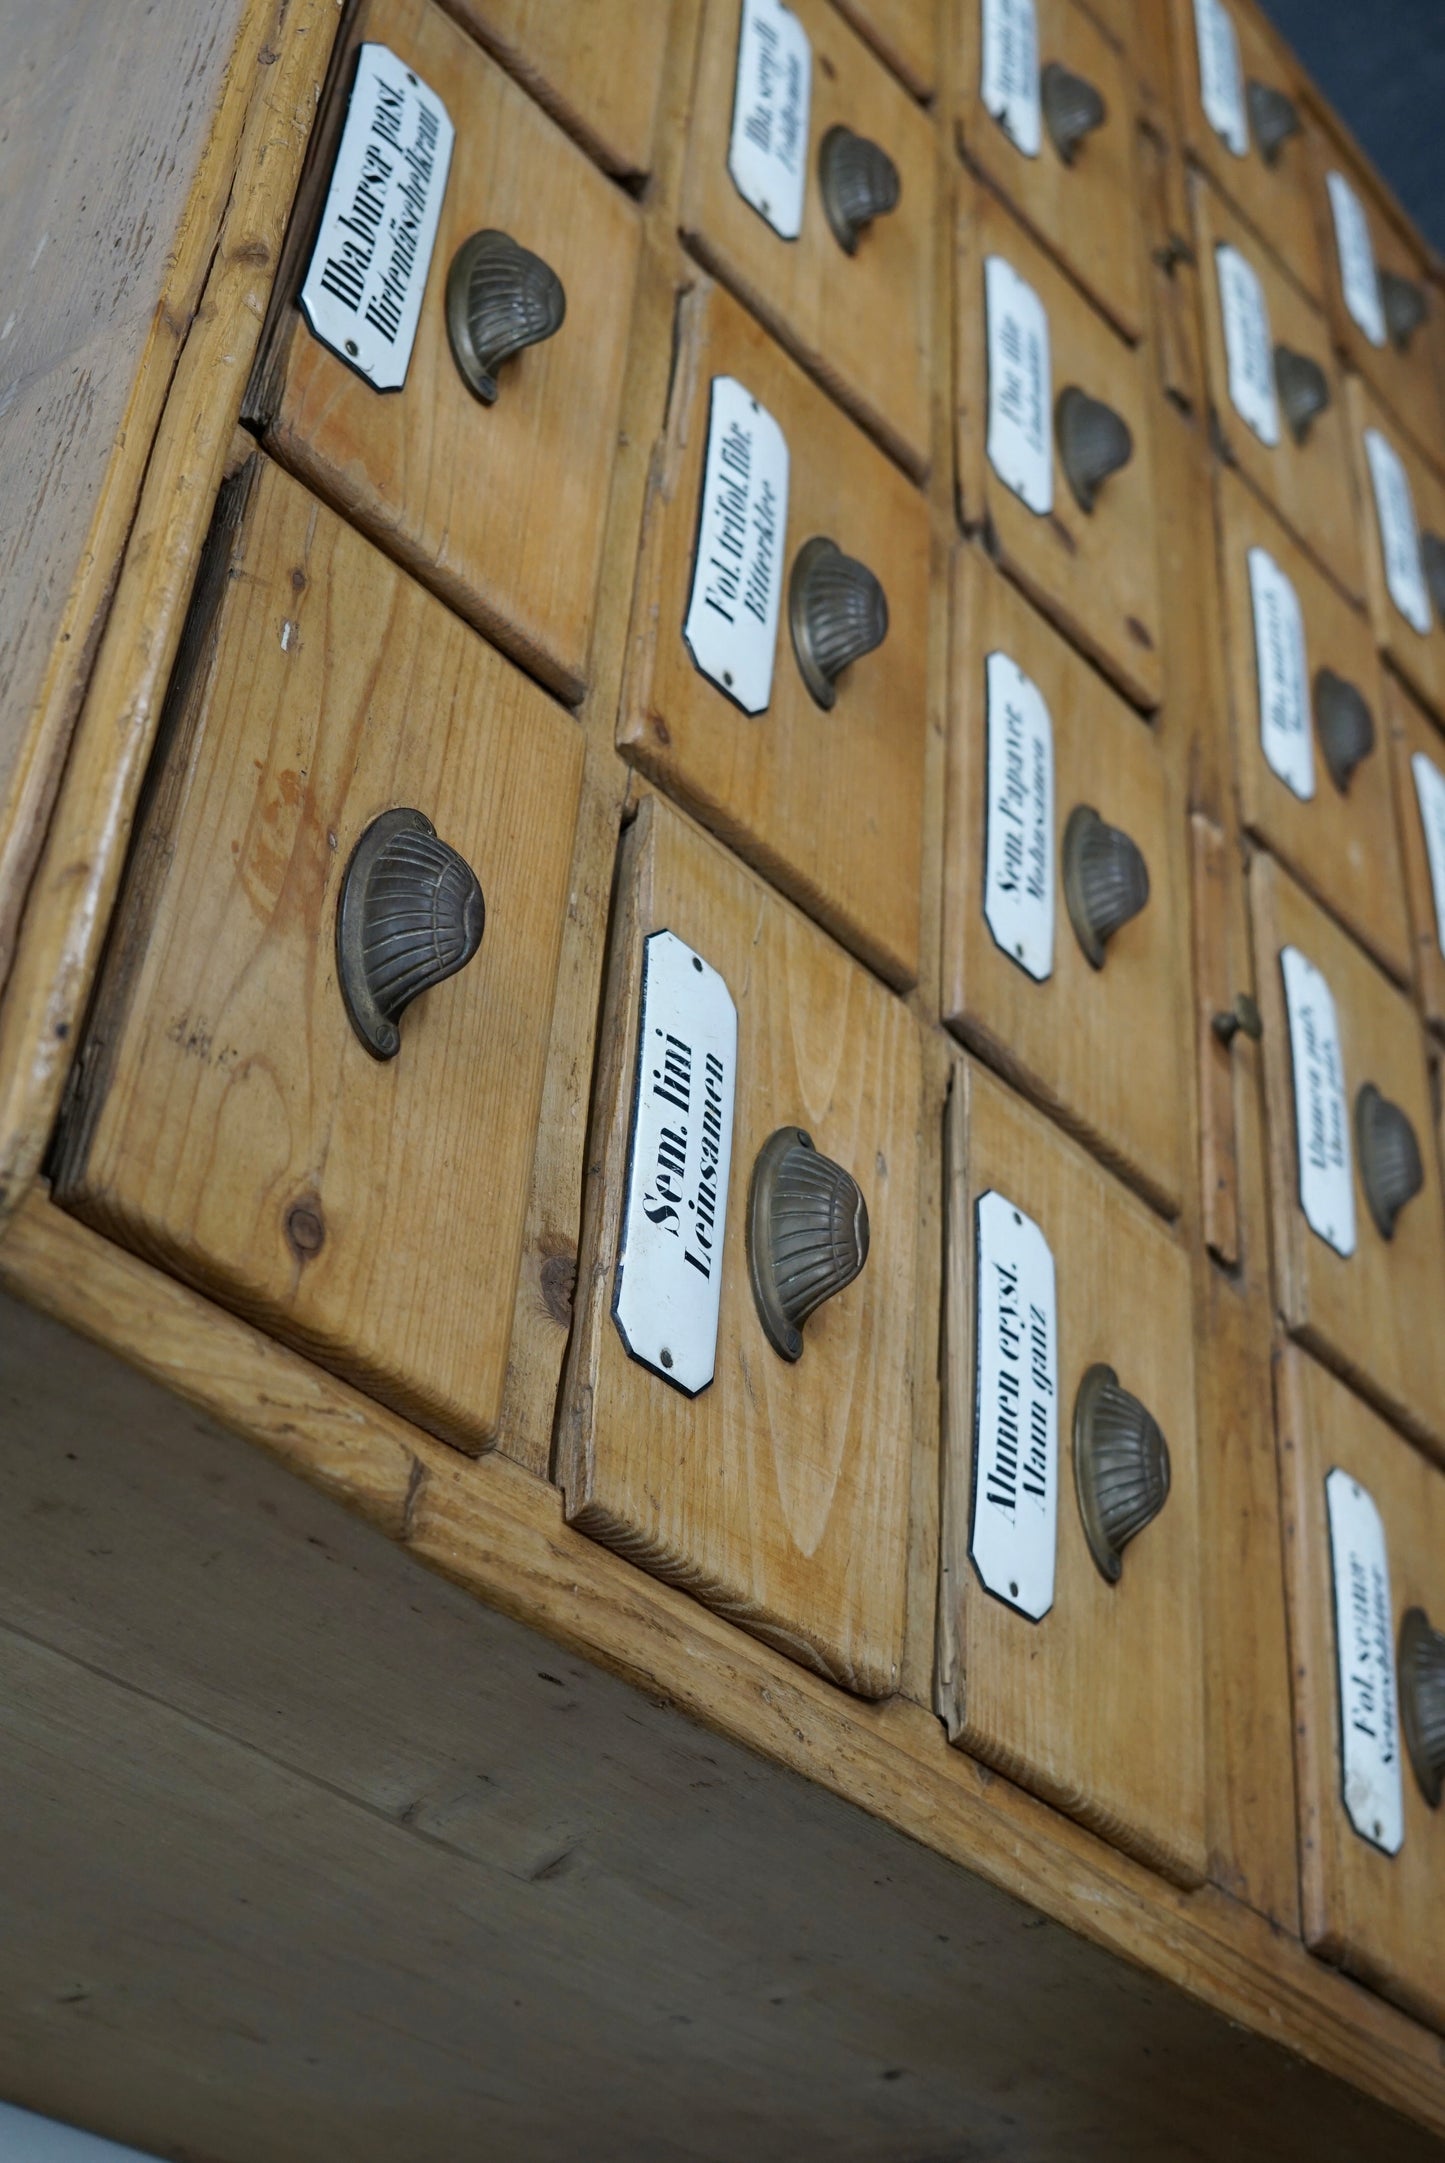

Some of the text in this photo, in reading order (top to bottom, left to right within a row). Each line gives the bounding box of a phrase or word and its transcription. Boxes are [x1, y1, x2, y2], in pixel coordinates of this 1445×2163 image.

[371, 76, 406, 156] past.
[365, 98, 440, 346] Hirtentäschelkraut
[705, 558, 741, 625] Fol.
[744, 481, 776, 626] Bitterklee
[643, 1028, 692, 1238] Sem. lini
[684, 1053, 724, 1281] Leinsamen
[986, 1262, 1026, 1525] Alumen cryst.
[1022, 1304, 1054, 1511] Alaun ganz
